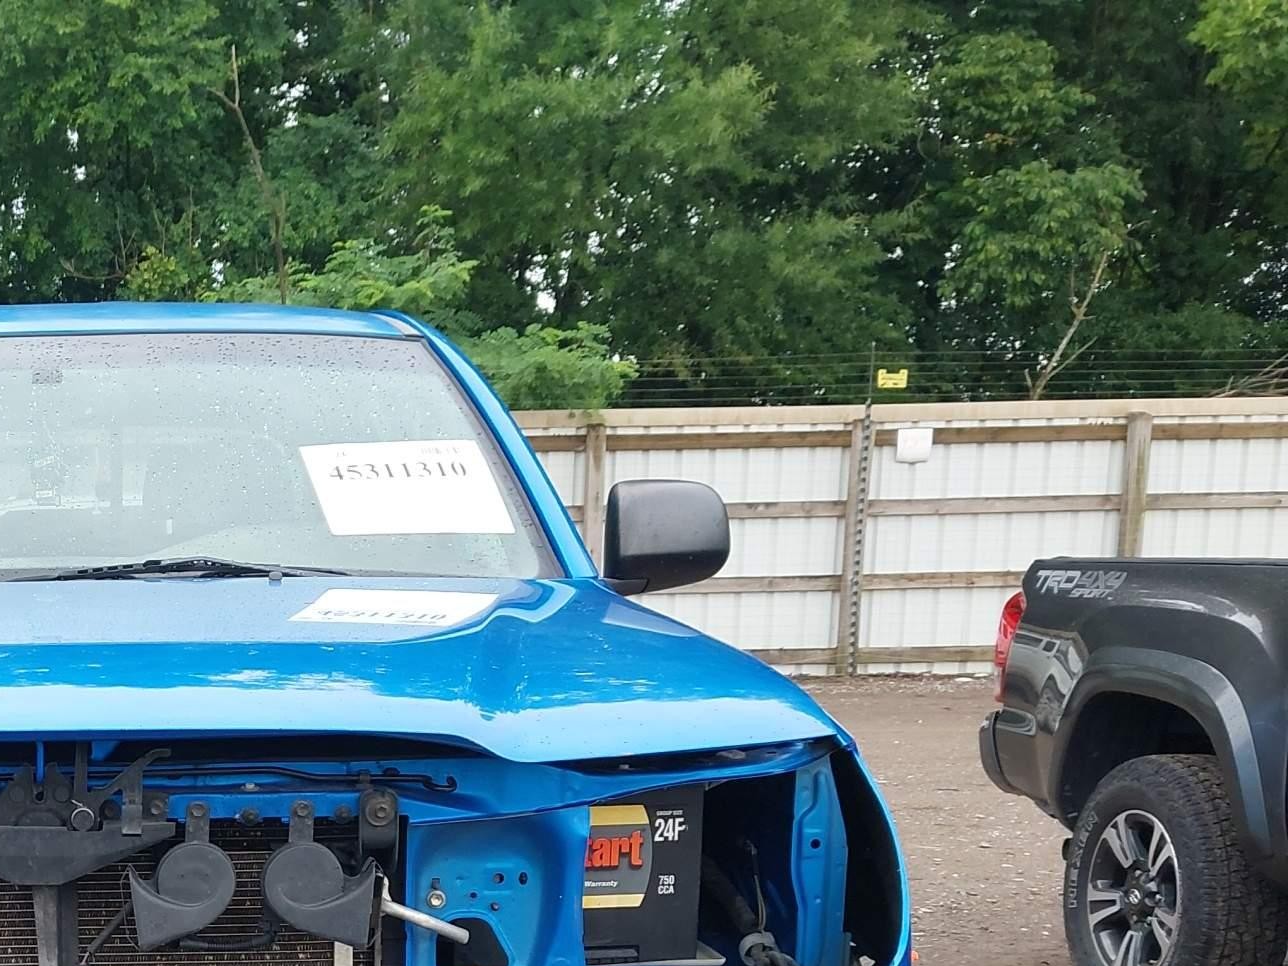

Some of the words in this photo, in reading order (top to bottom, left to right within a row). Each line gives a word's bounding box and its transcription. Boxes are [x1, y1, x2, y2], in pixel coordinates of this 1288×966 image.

[329, 461, 467, 480] 45311310
[1035, 570, 1082, 594] TRD
[1068, 587, 1114, 598] SPORT
[653, 817, 686, 842] 24F
[584, 880, 618, 888] Warranty
[658, 875, 675, 885] 750
[657, 885, 675, 895] CCA
